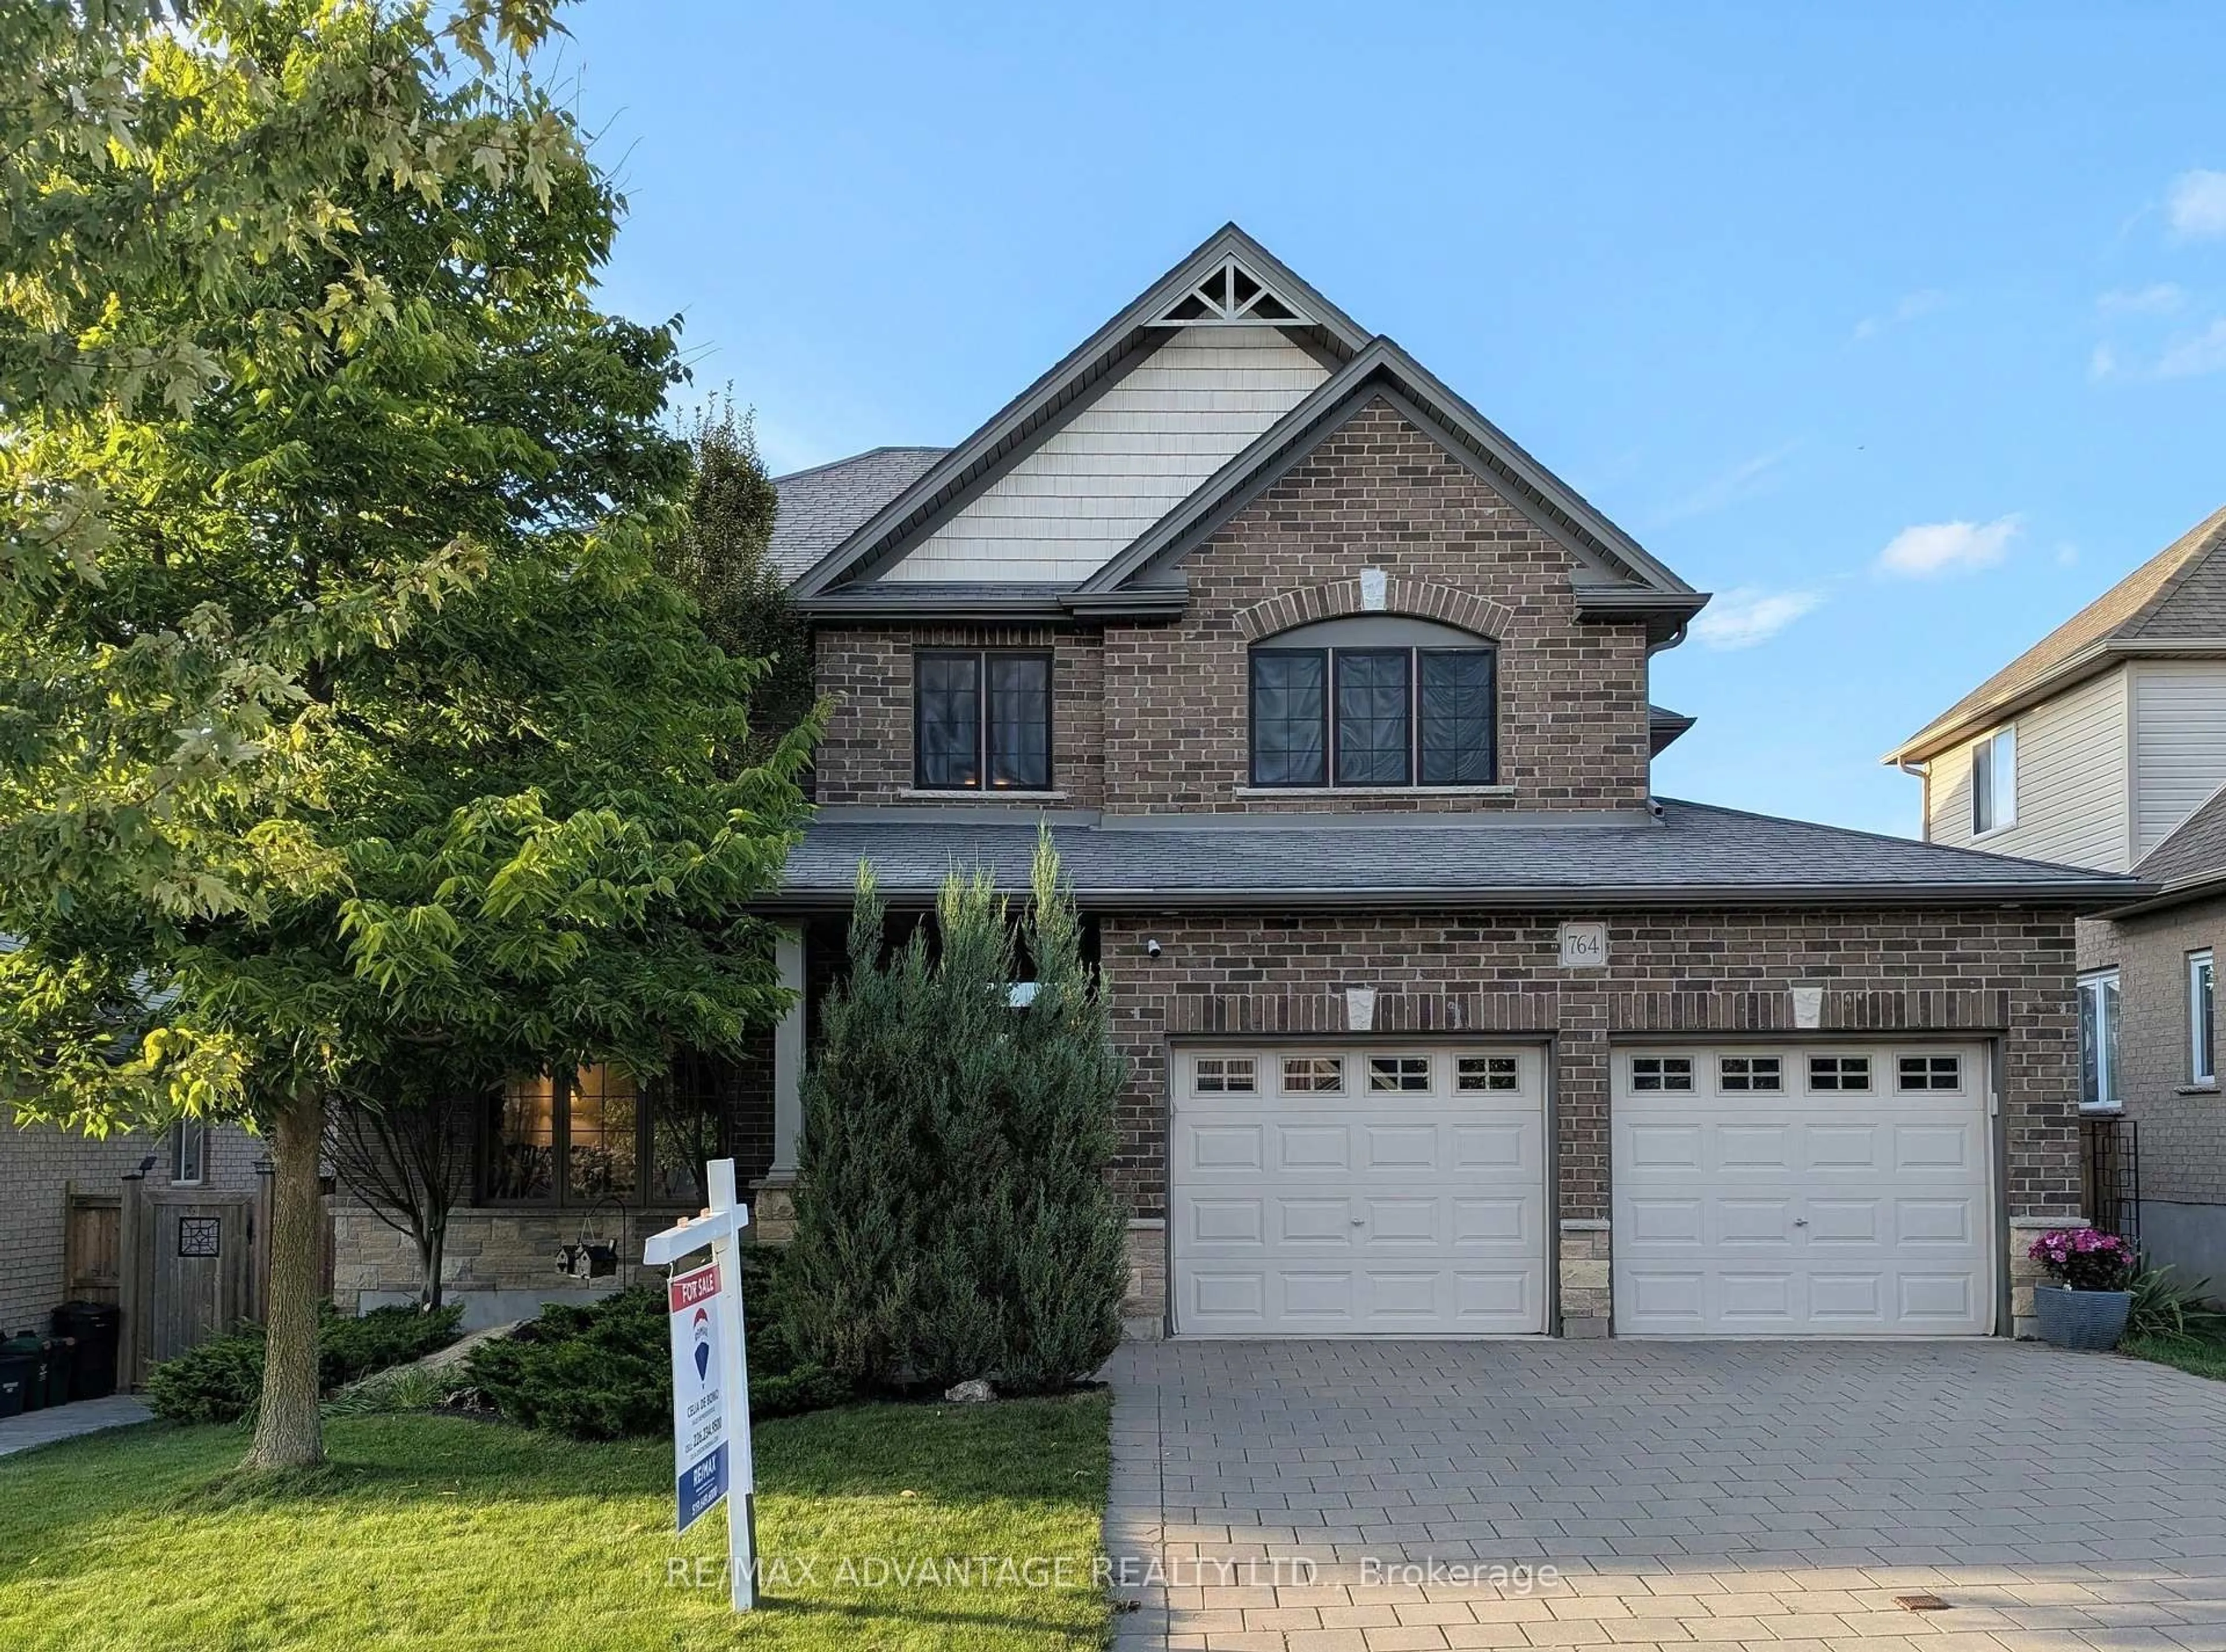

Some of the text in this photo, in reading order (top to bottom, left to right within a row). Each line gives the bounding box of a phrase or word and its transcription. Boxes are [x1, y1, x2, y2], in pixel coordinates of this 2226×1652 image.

[1568, 934, 1600, 955] 764
[682, 1273, 714, 1303] FOR SALE
[700, 1396, 707, 1410] DE
[693, 1453, 716, 1488] RE/MAX
